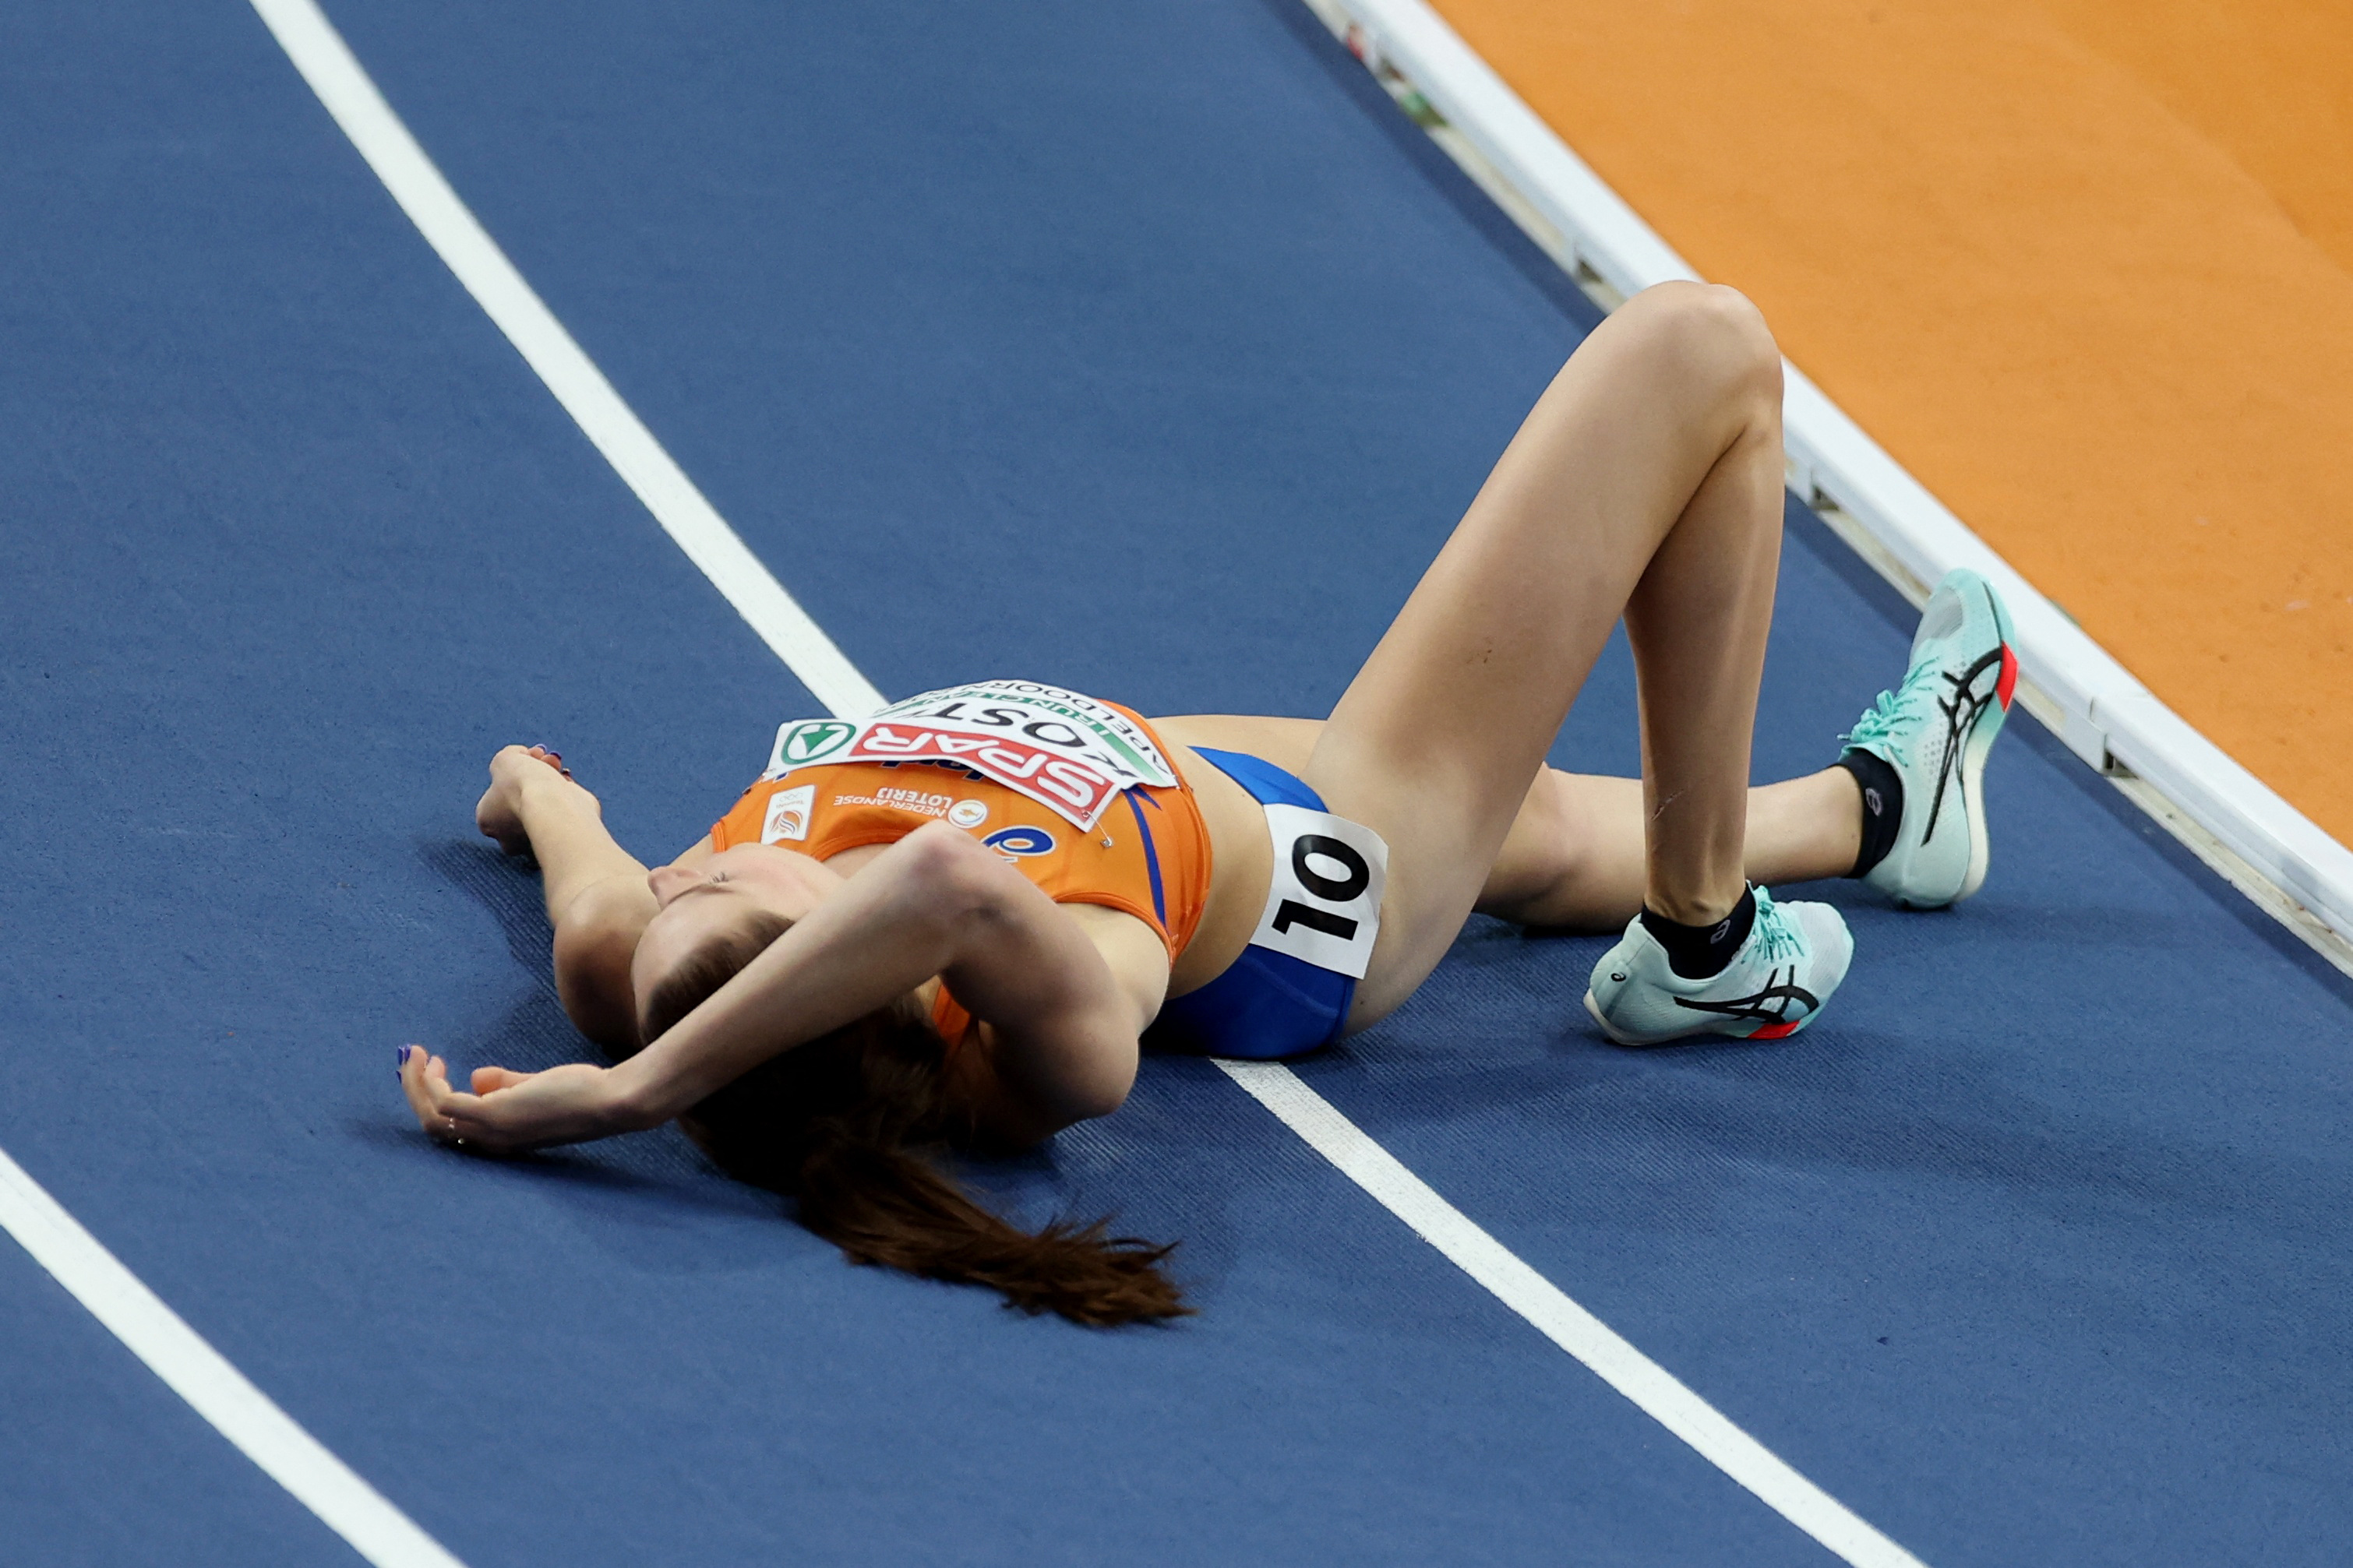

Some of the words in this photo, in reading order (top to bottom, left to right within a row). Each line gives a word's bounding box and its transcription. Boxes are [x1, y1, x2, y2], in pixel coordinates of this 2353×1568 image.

[960, 682, 1169, 774] APELDOORN
[1028, 700, 1095, 727] RUN
[863, 727, 1094, 809] SPAR
[834, 795, 947, 818] NEDERLANDSE
[877, 787, 953, 805] LOTERIJ
[1272, 834, 1370, 941] 10
